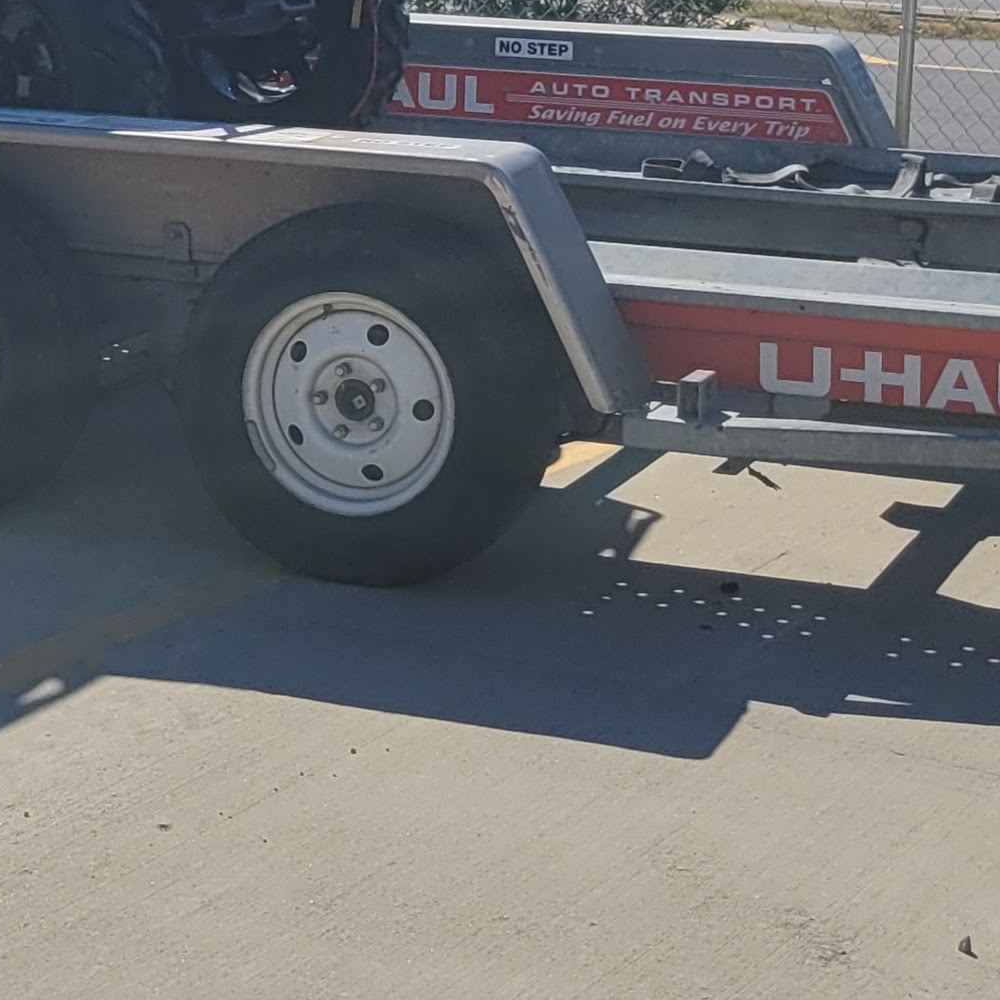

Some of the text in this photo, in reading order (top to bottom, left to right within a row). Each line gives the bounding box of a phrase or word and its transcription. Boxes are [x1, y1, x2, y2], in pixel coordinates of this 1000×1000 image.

[499, 40, 569, 57] NO STEP
[529, 81, 817, 112] AUTO TRANSPORT
[528, 104, 810, 140] Saving Fuel on Every Trip
[760, 342, 1000, 415] U-HA
